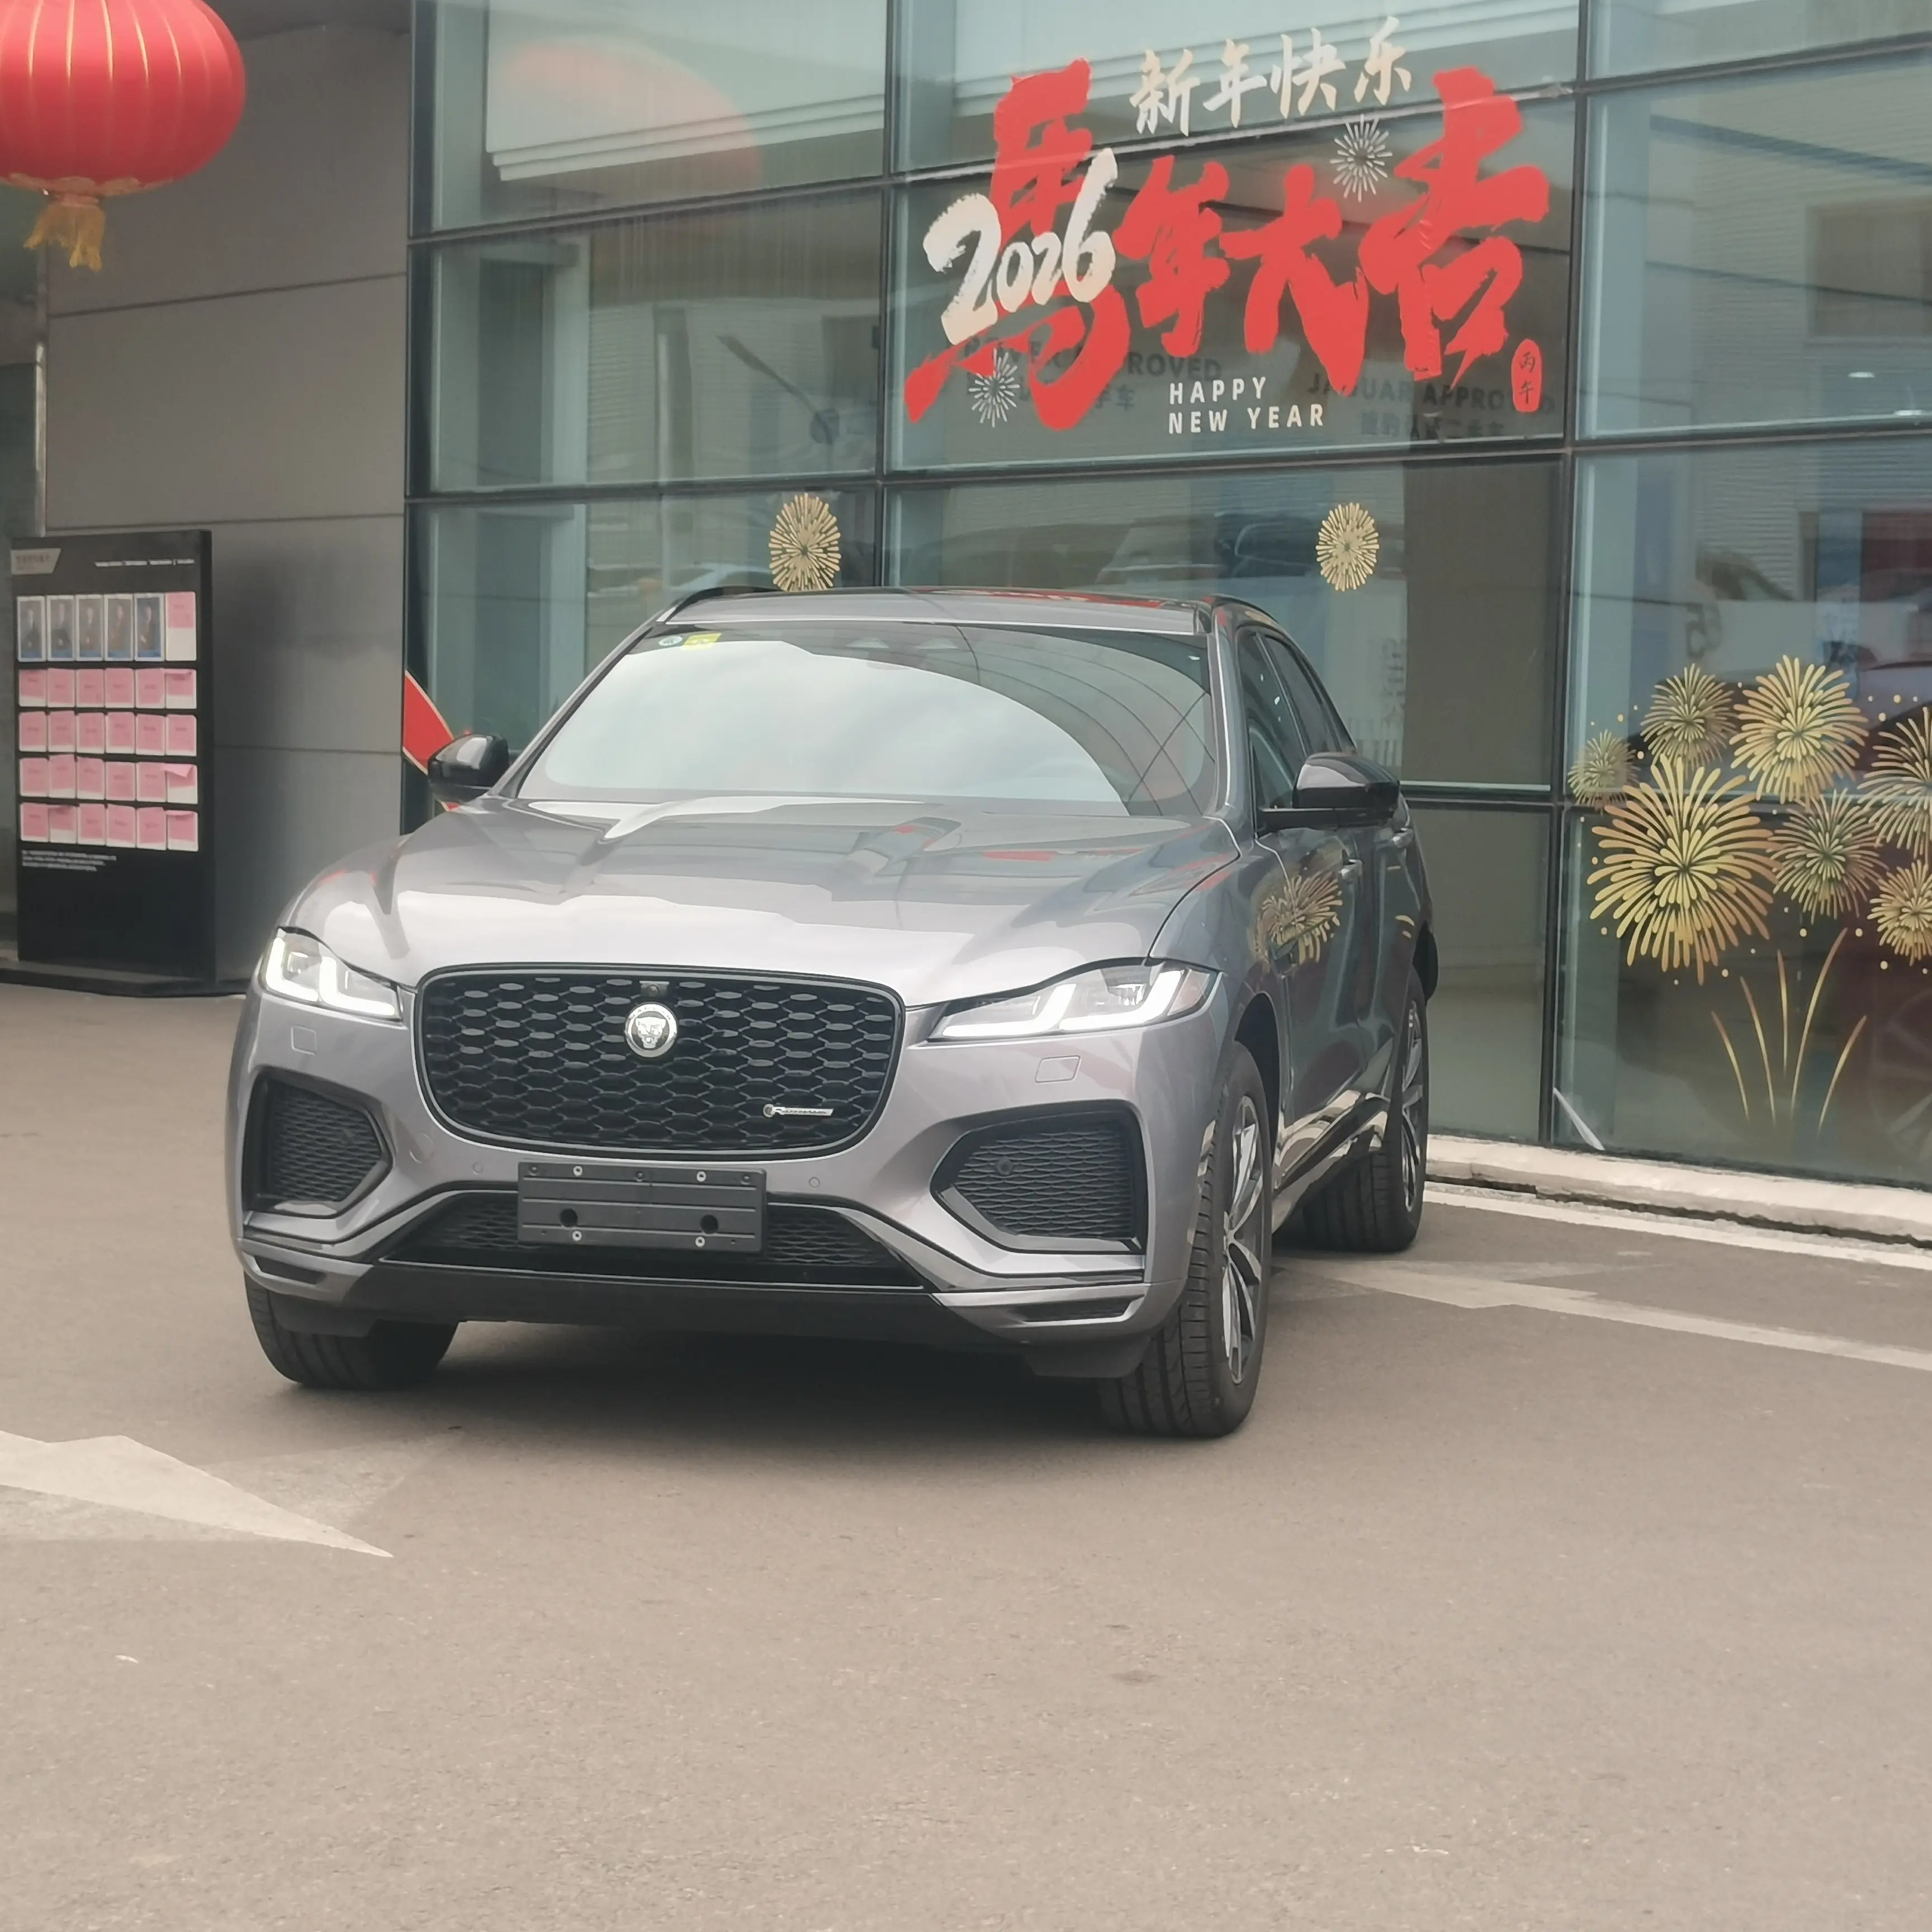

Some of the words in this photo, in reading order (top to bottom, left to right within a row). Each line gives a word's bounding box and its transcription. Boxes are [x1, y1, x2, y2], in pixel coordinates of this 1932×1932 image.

[1130, 16, 1412, 136] 新年快乐
[923, 148, 1117, 345] 2026
[1170, 377, 1266, 405] HAPPY
[1423, 383, 1556, 414] APPROD
[1169, 409, 1227, 434] NEW
[1247, 404, 1323, 429] YEAR
